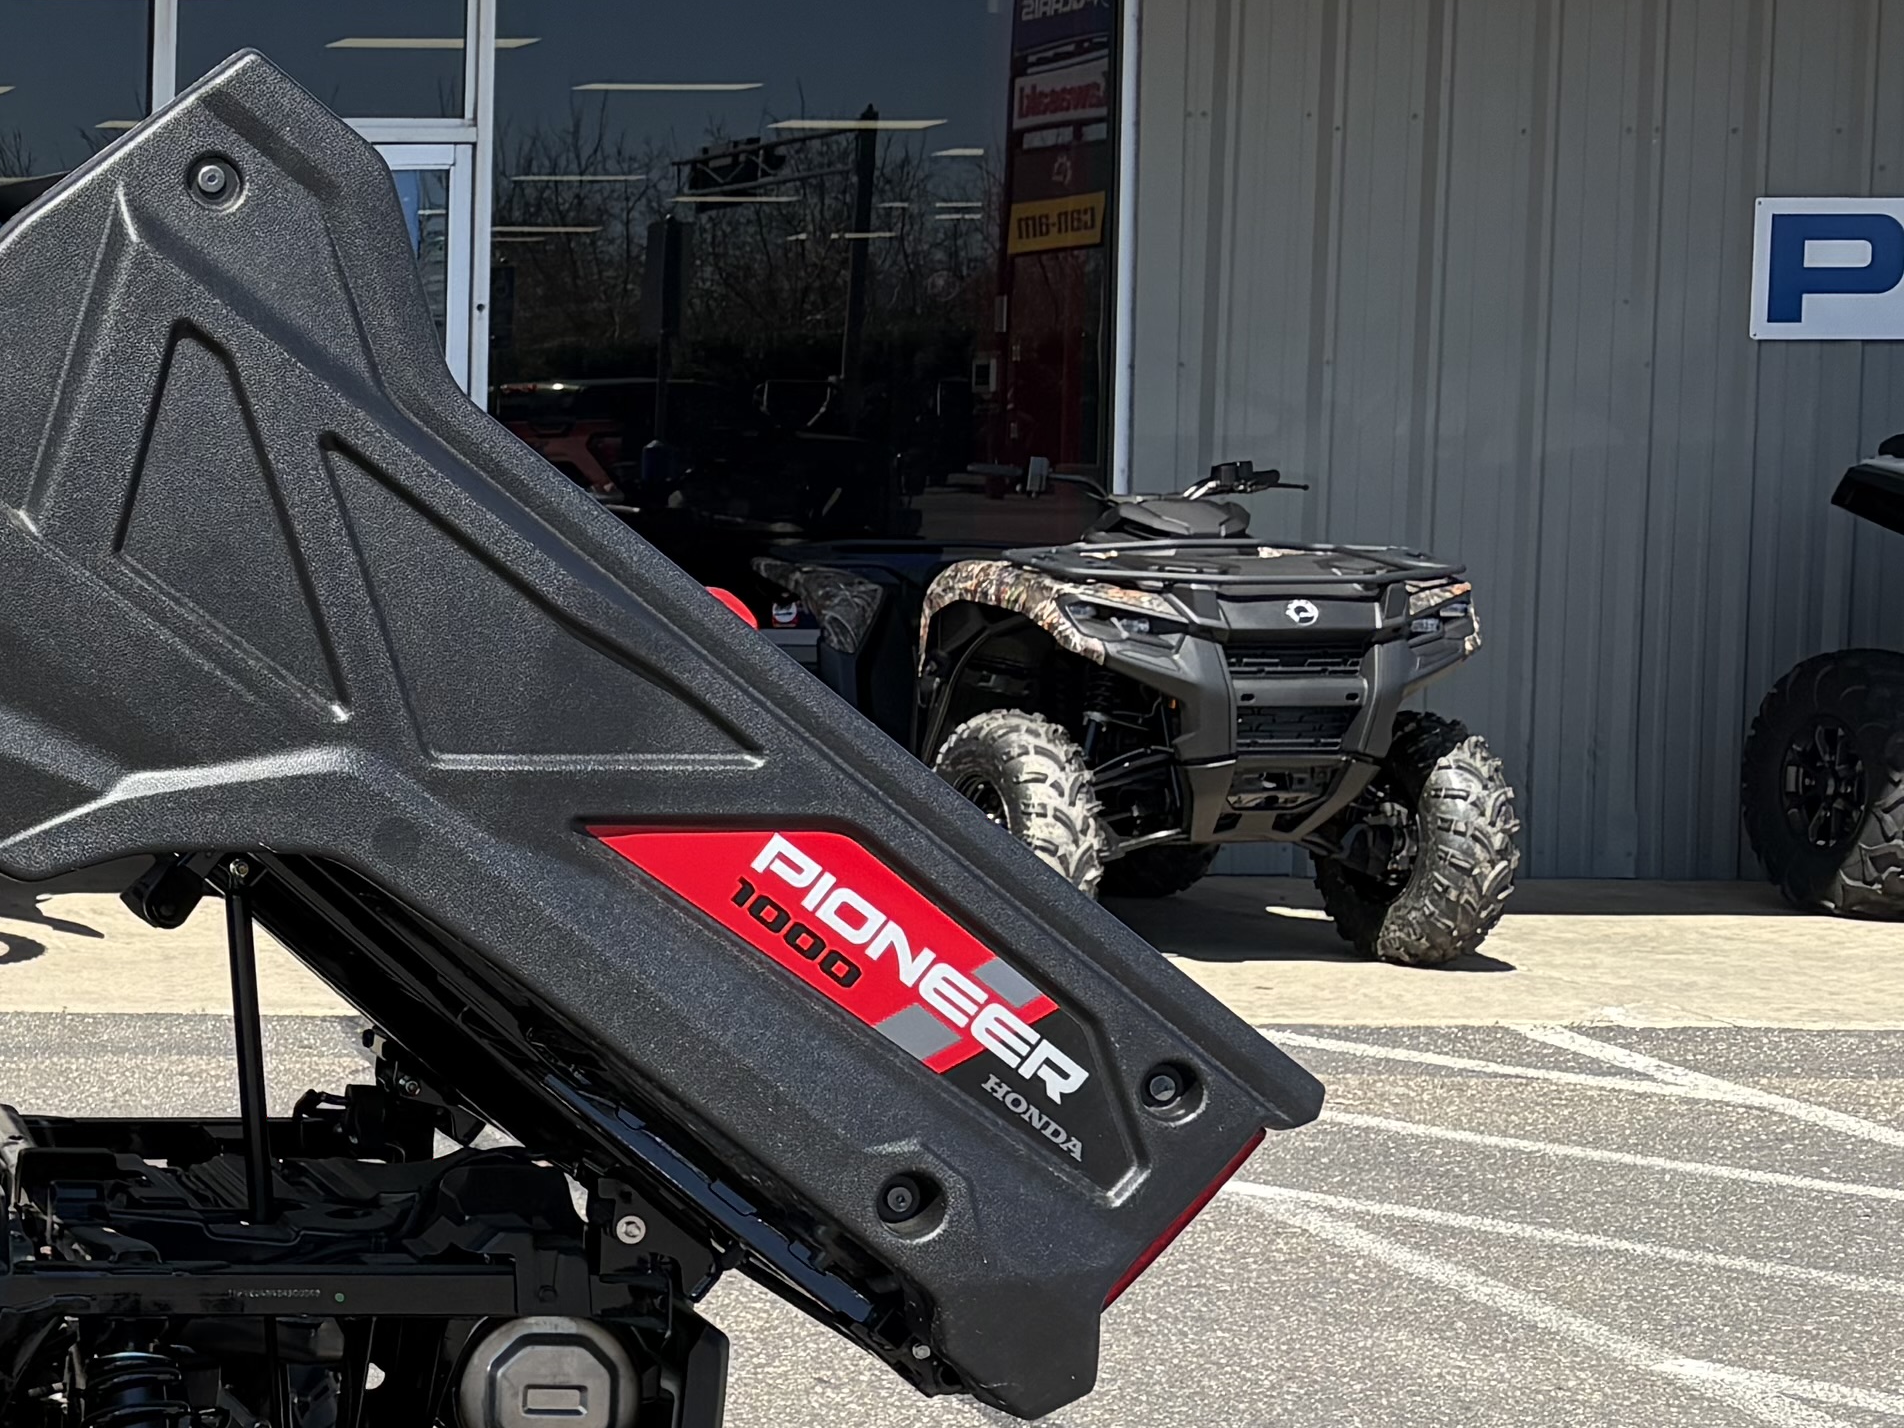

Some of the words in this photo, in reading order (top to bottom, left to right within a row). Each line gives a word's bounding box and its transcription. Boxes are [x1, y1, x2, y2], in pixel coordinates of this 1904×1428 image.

[729, 877, 862, 989] 1000
[751, 831, 1089, 1104] PIONEER
[981, 1074, 1085, 1162] HONDA
